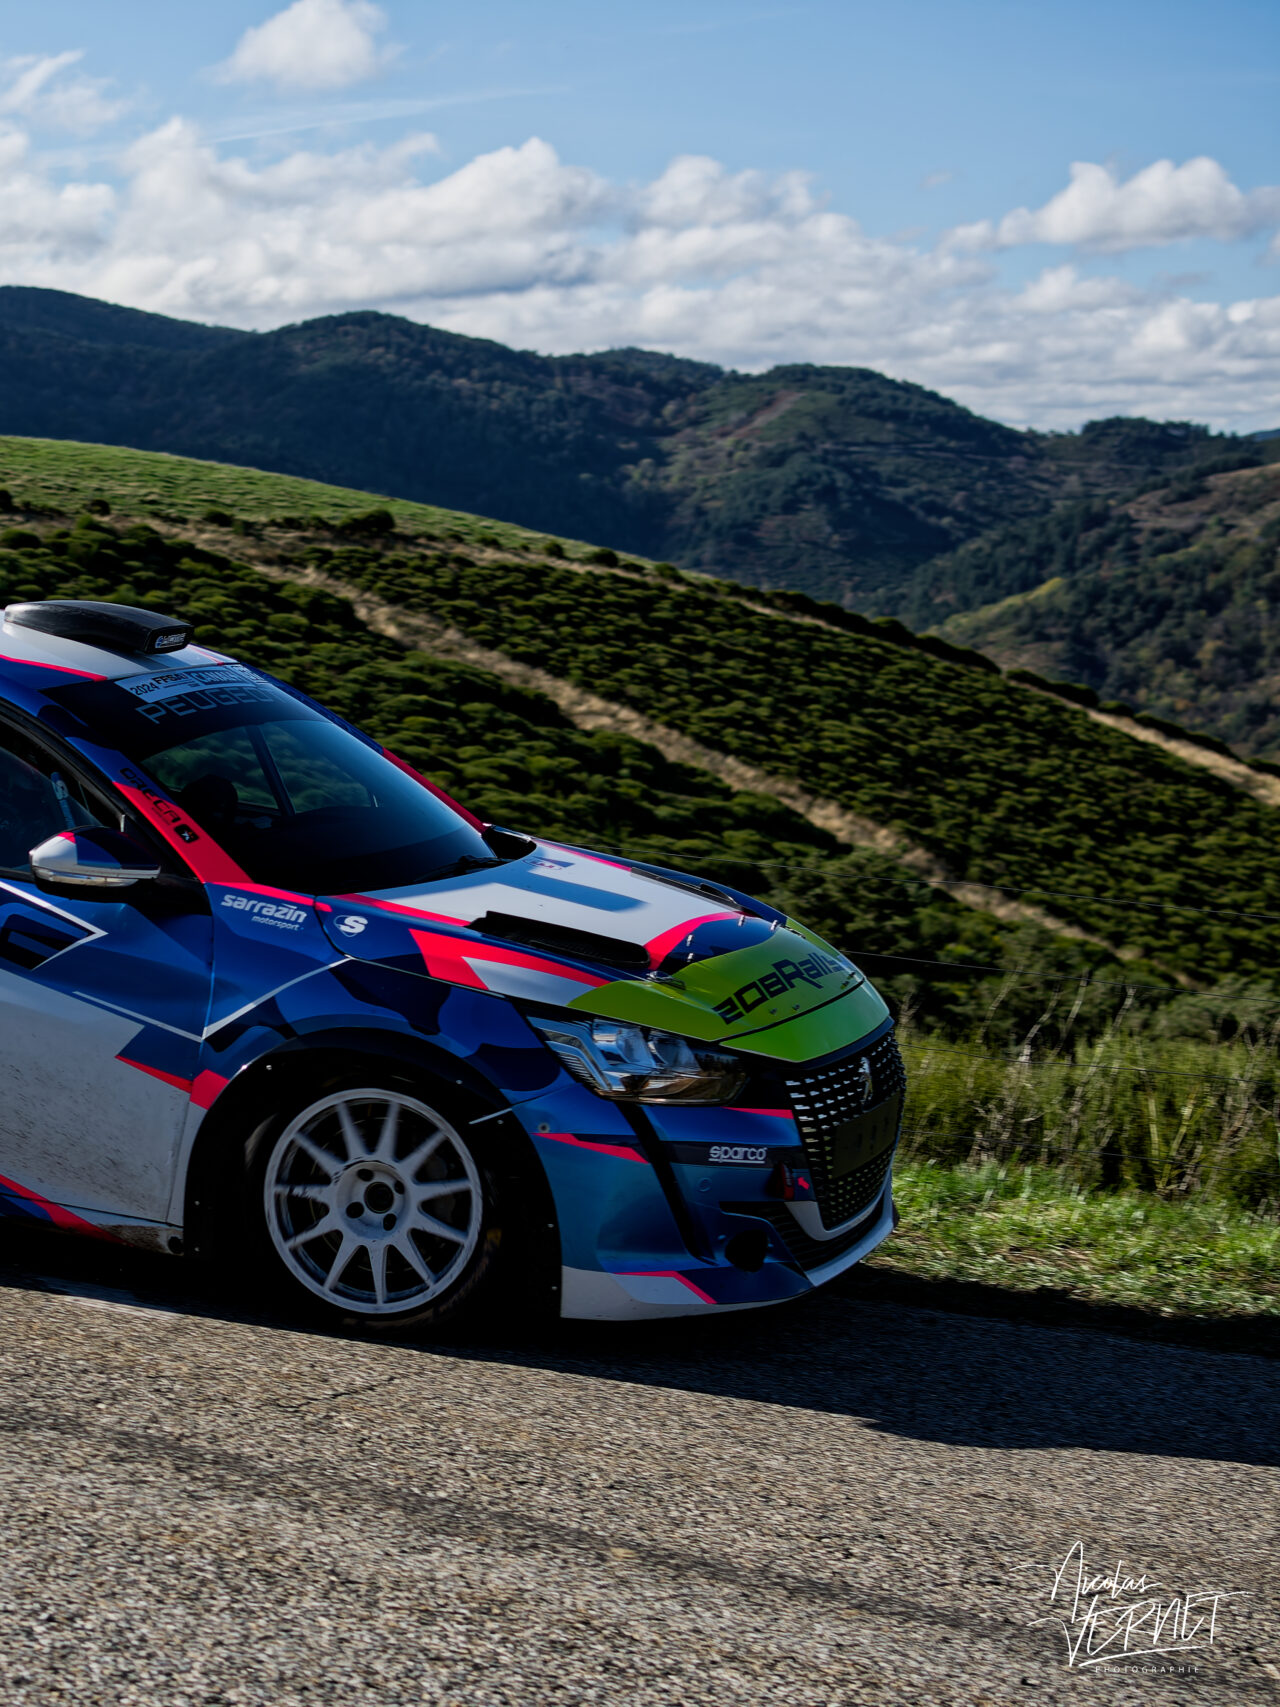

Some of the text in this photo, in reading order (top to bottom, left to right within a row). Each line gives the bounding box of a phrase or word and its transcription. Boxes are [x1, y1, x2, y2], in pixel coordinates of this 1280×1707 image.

[129, 681, 160, 696] 2024
[120, 767, 181, 823] ORECA
[221, 894, 308, 923] sarrazin
[251, 915, 301, 932] motorsport
[708, 1145, 768, 1164] sparco
